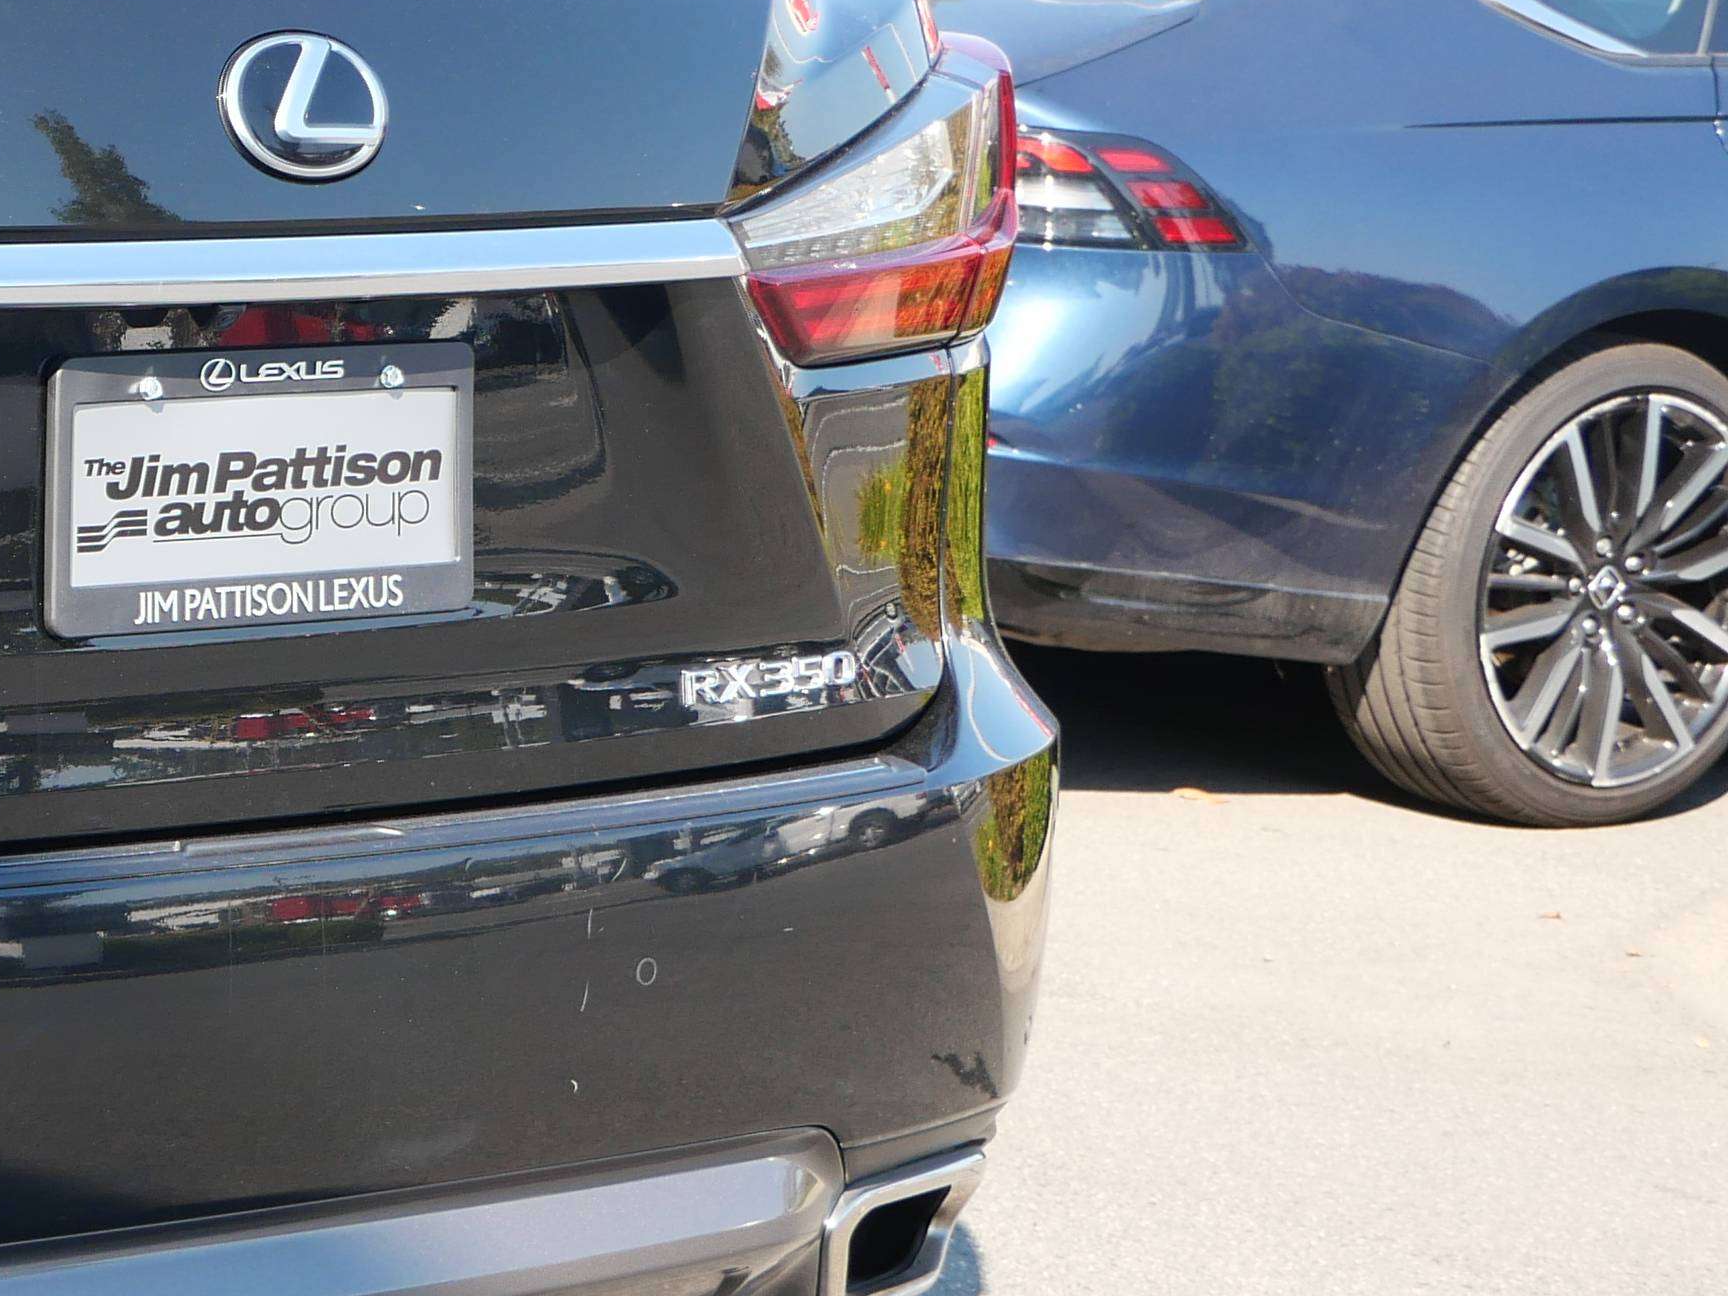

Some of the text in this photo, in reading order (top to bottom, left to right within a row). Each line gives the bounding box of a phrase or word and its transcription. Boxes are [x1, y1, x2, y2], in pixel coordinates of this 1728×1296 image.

[240, 359, 344, 383] LEXUS
[84, 445, 442, 500] The Jim Pattison
[135, 574, 403, 625] JIM PATTISON LEXUS
